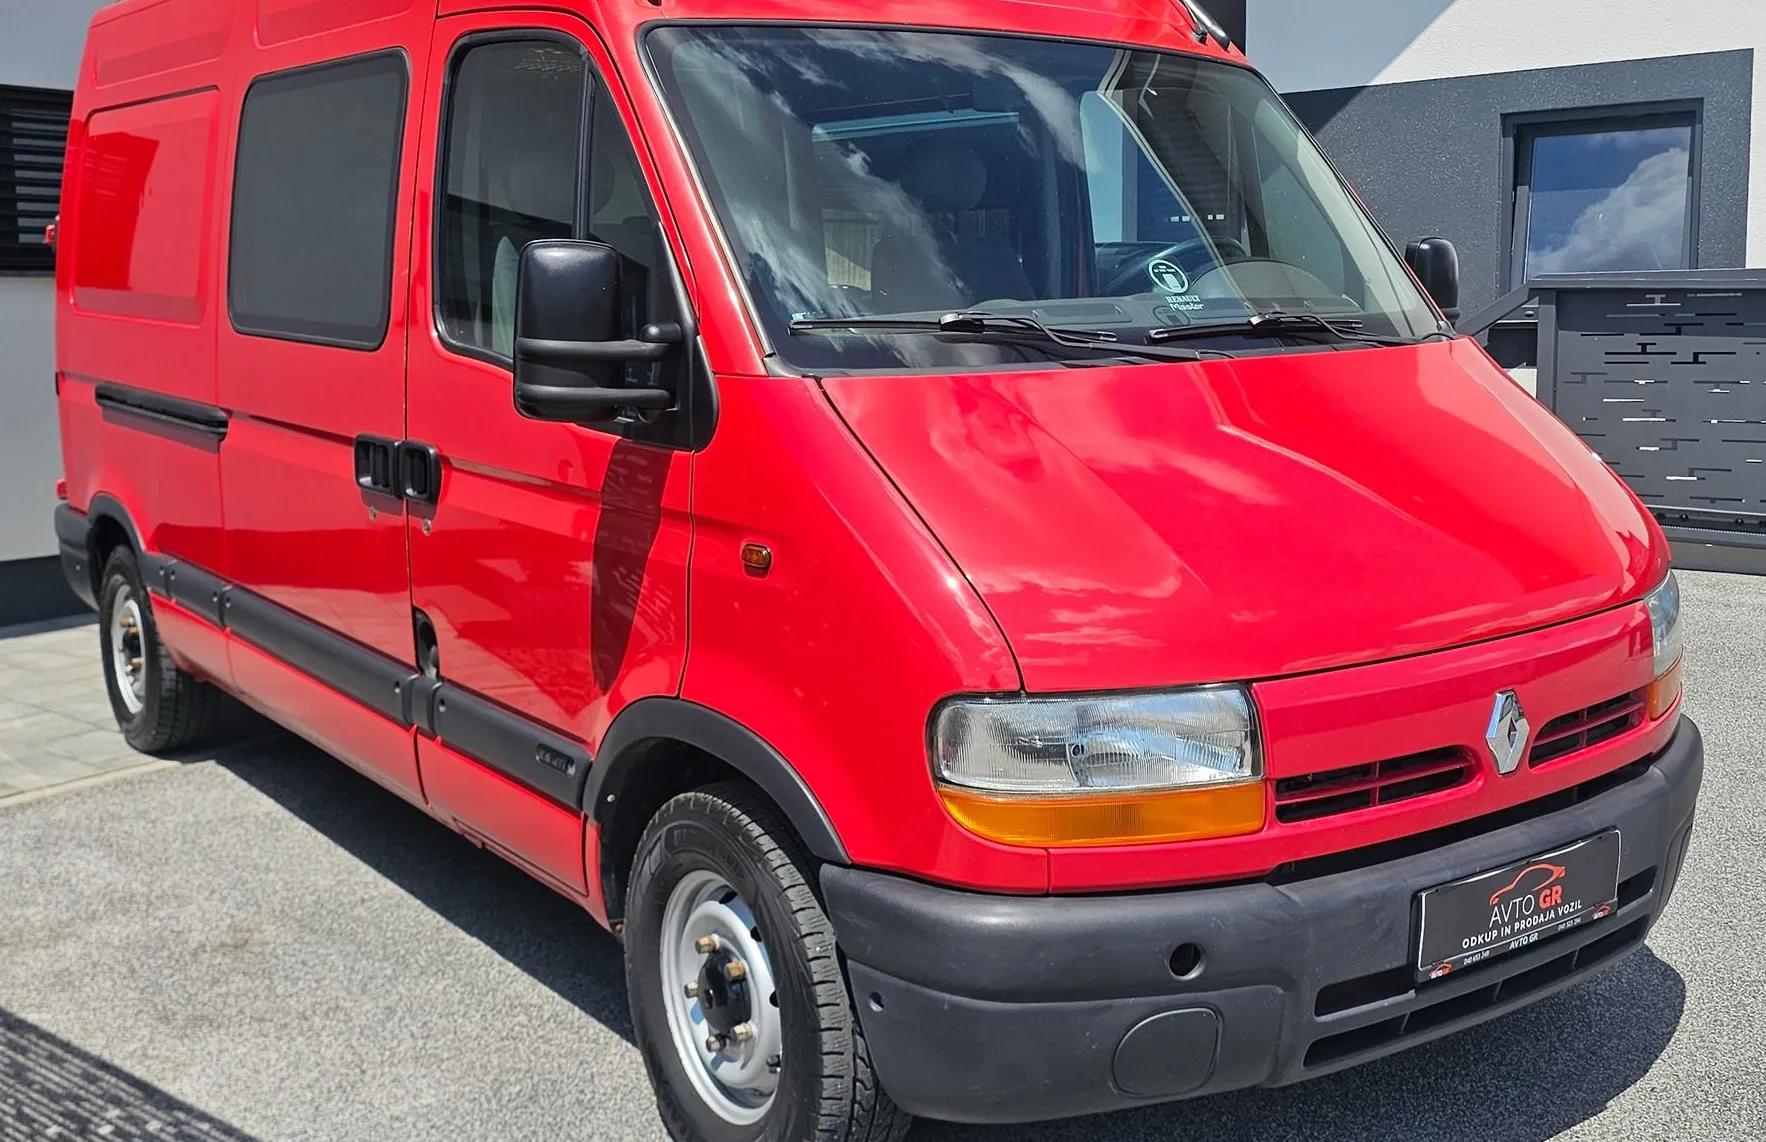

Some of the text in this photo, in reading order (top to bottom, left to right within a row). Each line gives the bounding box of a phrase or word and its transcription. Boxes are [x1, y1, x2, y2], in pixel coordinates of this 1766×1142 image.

[1165, 295, 1200, 303] RENAULT
[1169, 303, 1204, 311] Master
[1489, 885, 1563, 928] AVTO GR
[1462, 929, 1498, 949] ODKUP
[1501, 924, 1511, 938] IN
[1514, 910, 1555, 932] PRODAJA
[1557, 899, 1582, 916] VOZIL
[1509, 932, 1539, 950] AVTO GR
